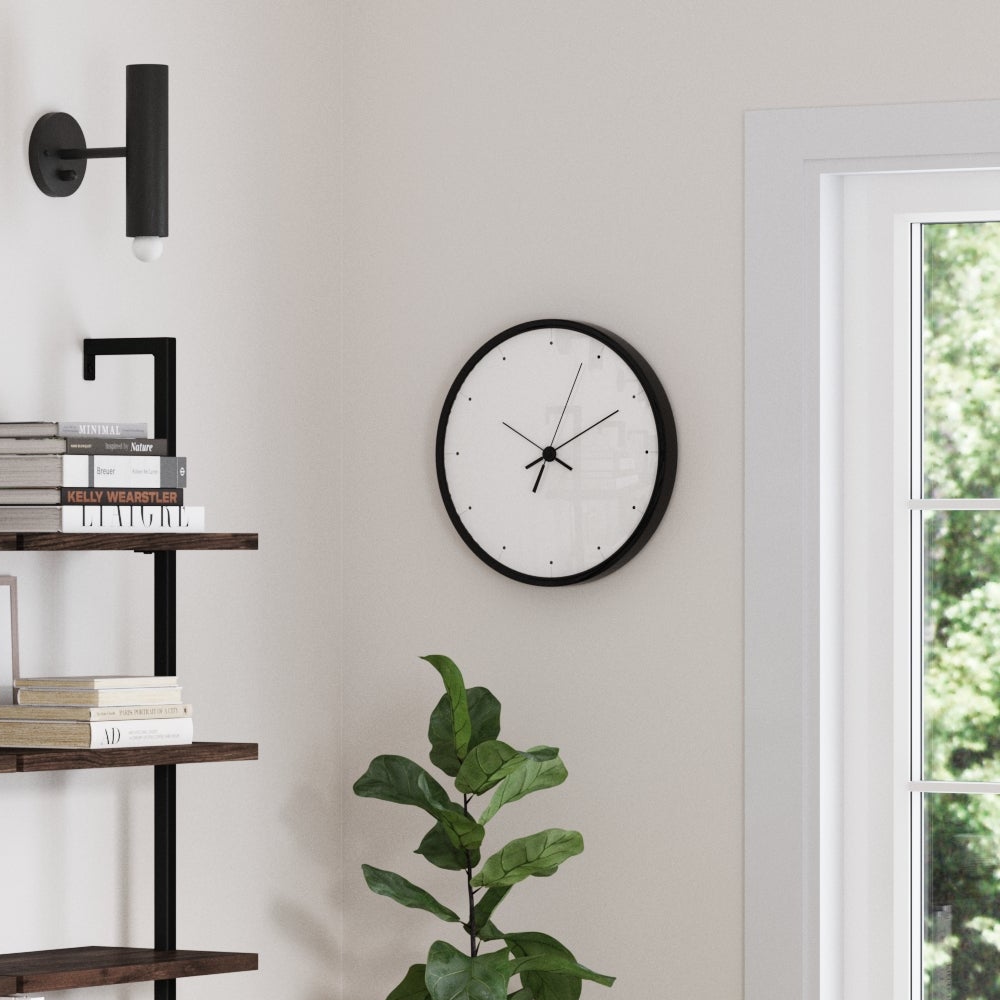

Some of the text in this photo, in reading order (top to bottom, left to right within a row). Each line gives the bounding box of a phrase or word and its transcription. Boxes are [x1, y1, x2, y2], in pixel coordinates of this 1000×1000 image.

[78, 424, 121, 435] MINIMAL
[130, 442, 154, 452] Nature
[96, 466, 116, 475] Breuer
[67, 491, 177, 503] KELLY WEARSTLER
[102, 727, 121, 745] AD
